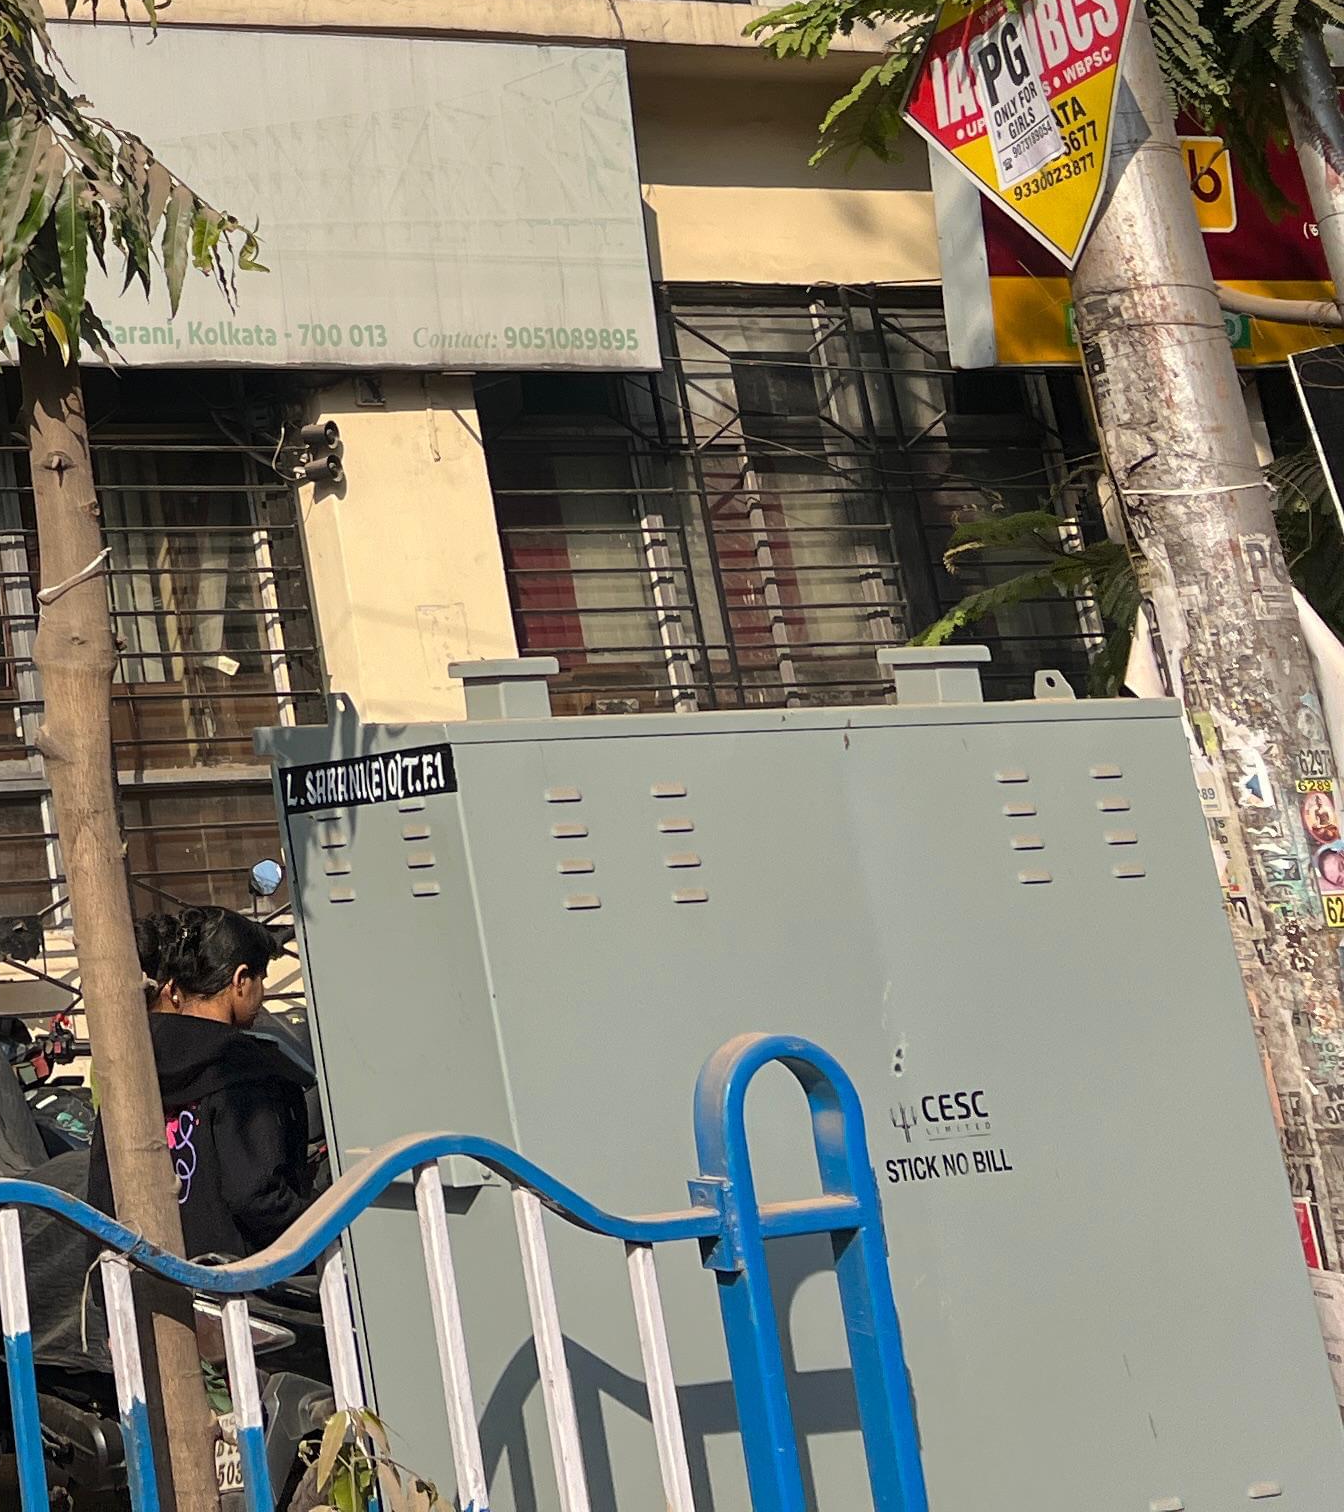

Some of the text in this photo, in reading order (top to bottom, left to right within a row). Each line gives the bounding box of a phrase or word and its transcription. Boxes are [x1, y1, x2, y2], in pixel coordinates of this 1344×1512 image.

[978, 21, 1030, 107] PG
[1063, 46, 1112, 81] WBPSC
[994, 95, 1018, 126] ONLY
[1015, 81, 1038, 109] FOR
[1009, 113, 1035, 140] GIRLS
[188, 322, 277, 347] Kolkata
[298, 323, 343, 348] 700
[349, 324, 388, 348] 013
[412, 326, 497, 350] Contact:
[503, 326, 639, 352] 9051089895
[921, 1091, 988, 1122] CESC
[926, 1122, 991, 1135] LIMITED
[886, 1149, 1013, 1183] STICK NO BILL
